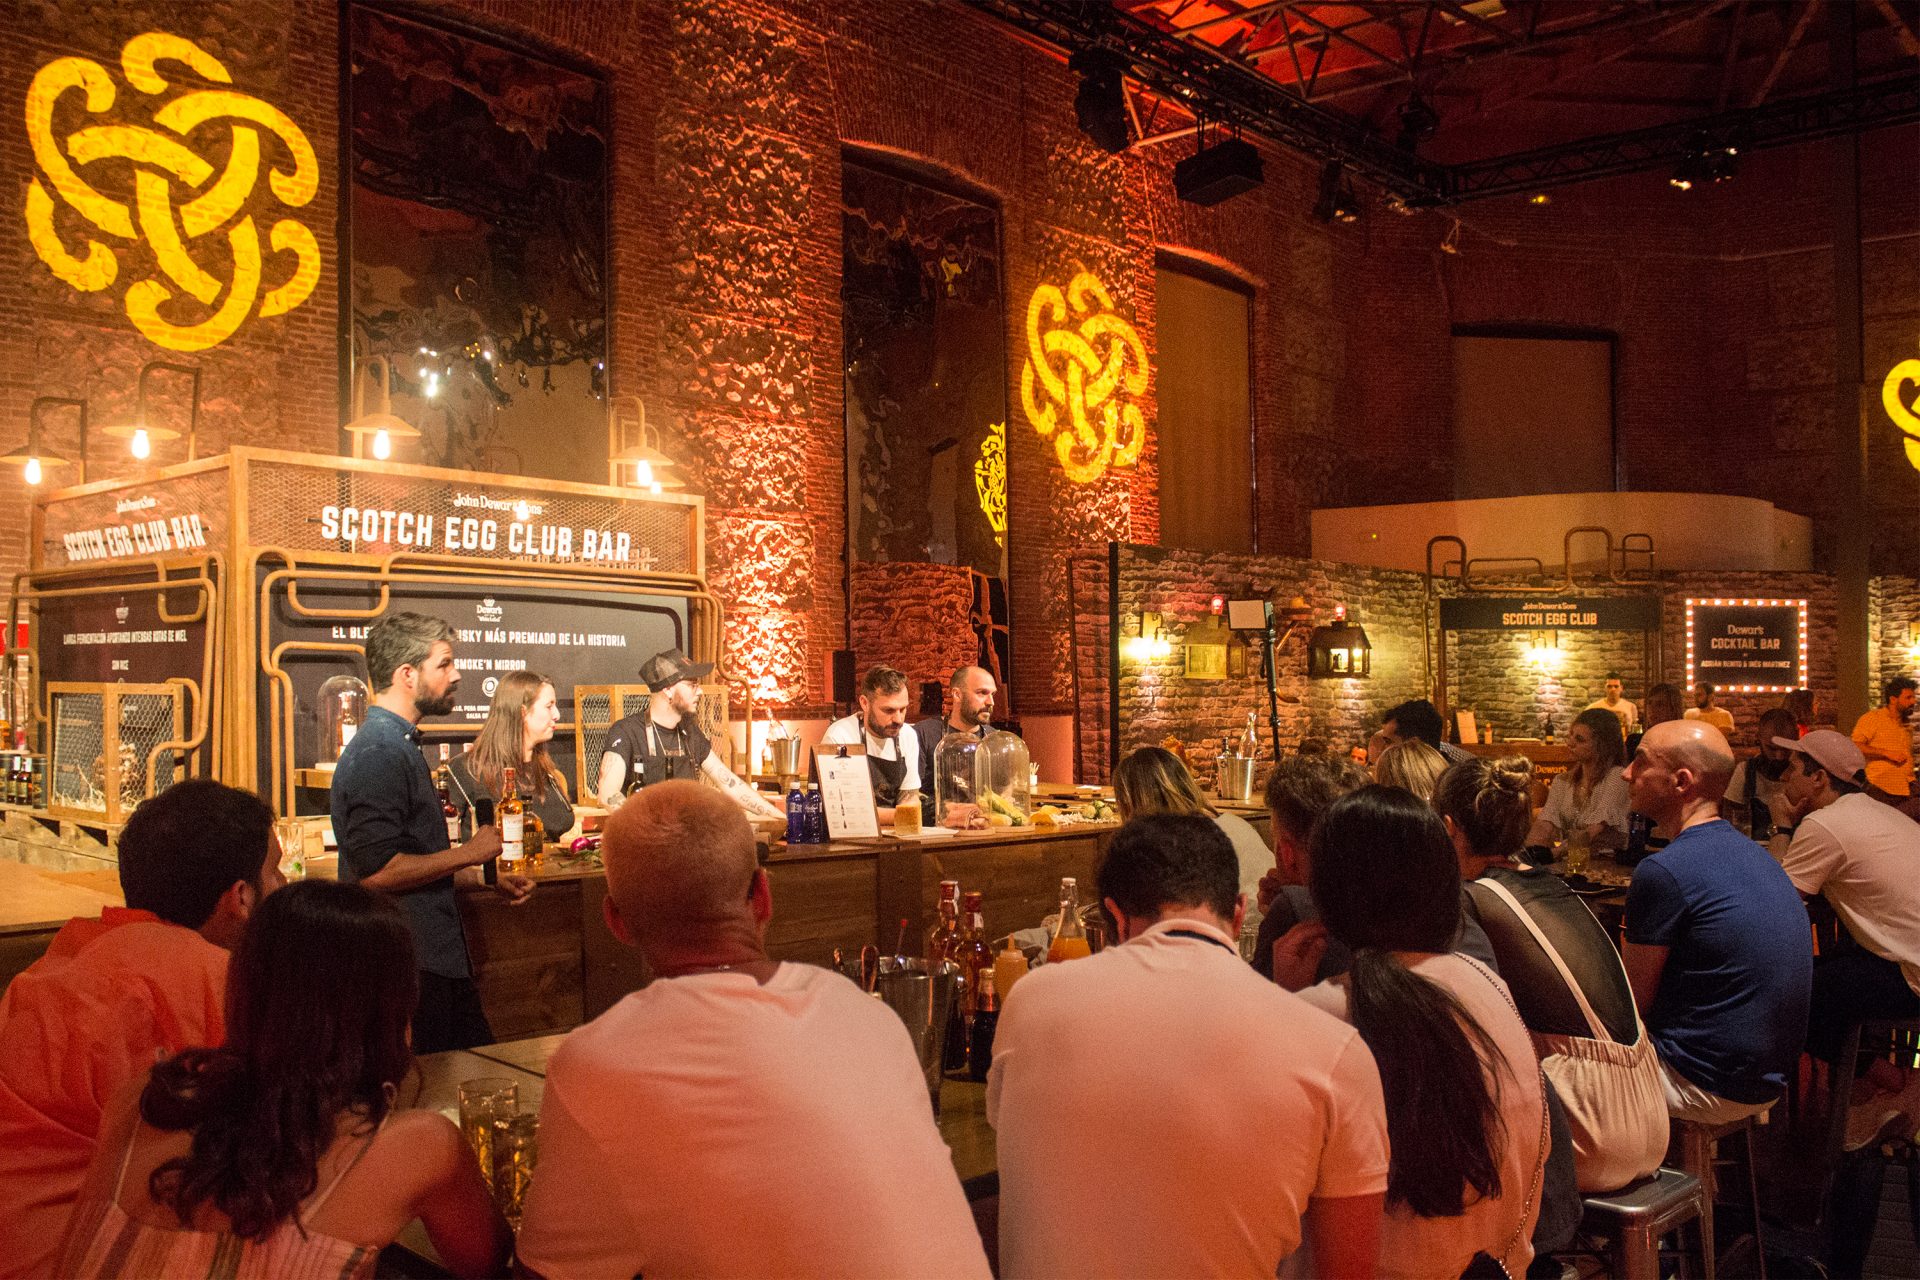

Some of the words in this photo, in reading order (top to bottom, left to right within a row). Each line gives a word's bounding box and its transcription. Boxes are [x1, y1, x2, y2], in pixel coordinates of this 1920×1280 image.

[453, 493, 479, 507] John
[480, 495, 512, 511] Dewar
[63, 528, 107, 561] SCOTCH
[105, 525, 134, 557] EGG
[132, 519, 172, 554] CLUB
[170, 514, 206, 549] BAR
[321, 505, 433, 547] SCOTCH
[445, 516, 497, 551] EGG
[508, 522, 573, 557] CLUB
[582, 528, 631, 562] BAR
[1502, 612, 1543, 625] SCOTCH
[1545, 612, 1567, 625] EGG
[1569, 612, 1598, 625] CLUB
[1727, 624, 1765, 635] Dewar's
[332, 626, 347, 638] EL
[350, 626, 373, 639] BLE
[457, 629, 482, 643] ISKY
[484, 628, 506, 643] MÁS
[508, 631, 557, 645] PREMIADO
[558, 632, 570, 645] DE
[572, 633, 586, 646] LA
[587, 634, 627, 647] HISTORIA
[1711, 638, 1758, 649] COCKTAIL
[1760, 638, 1780, 649] BAR
[453, 658, 493, 670] SMOKE'N
[494, 659, 527, 671] MIRROR
[1535, 765, 1568, 774] Dewar's
